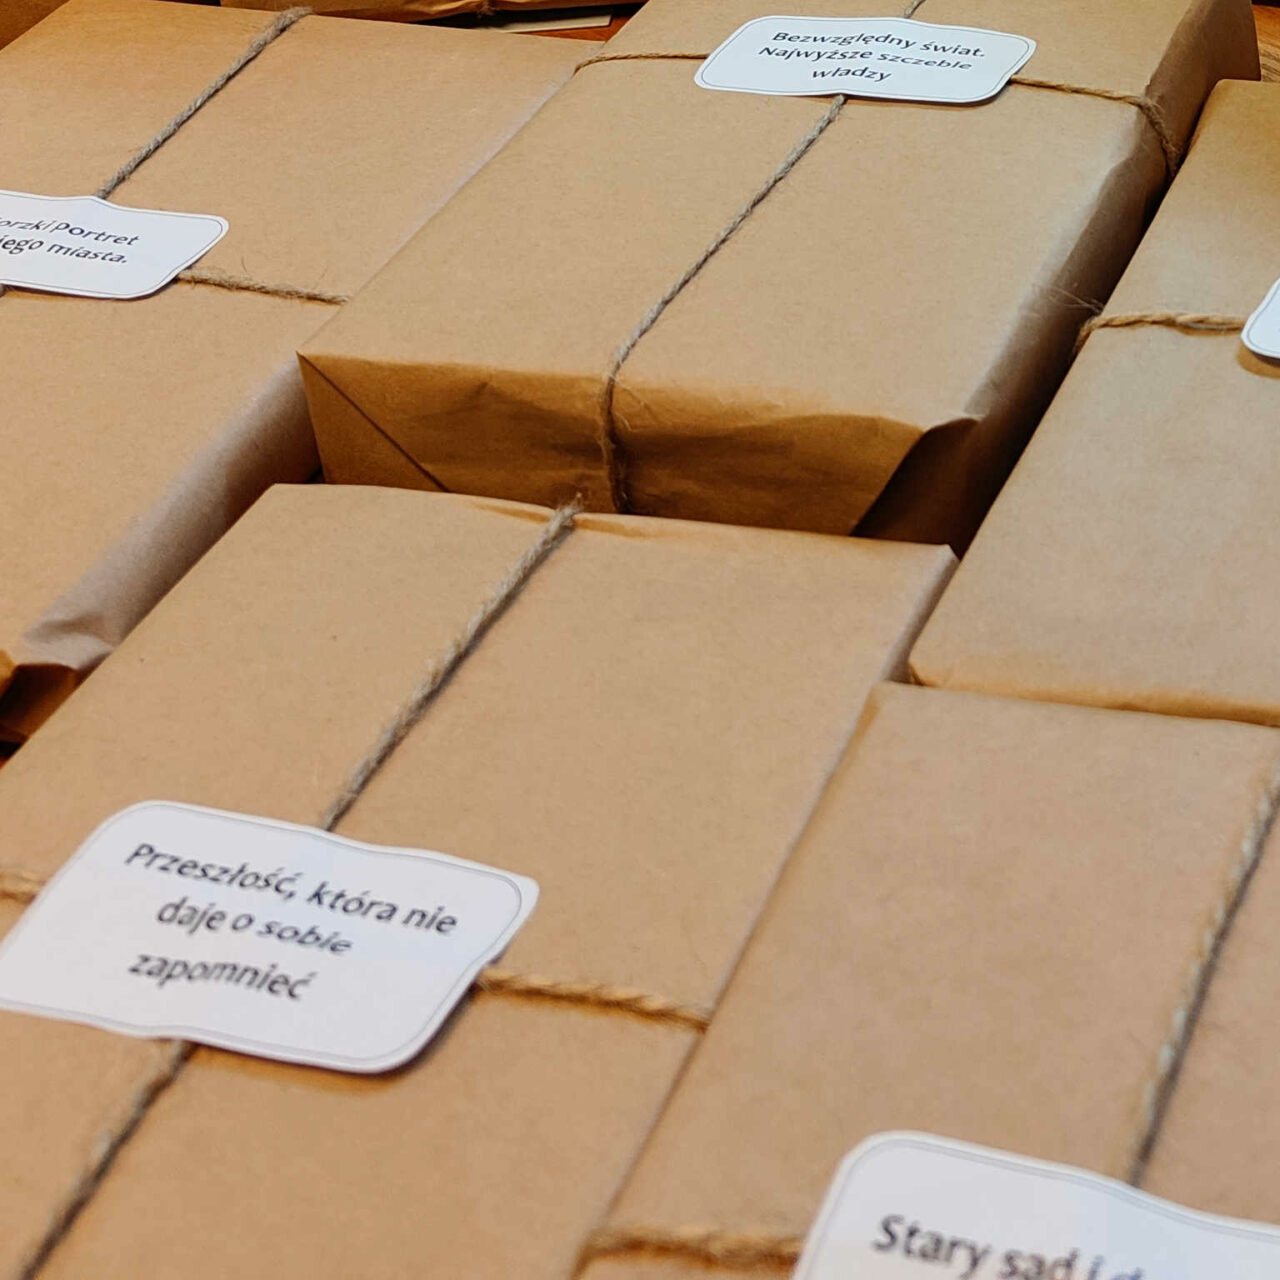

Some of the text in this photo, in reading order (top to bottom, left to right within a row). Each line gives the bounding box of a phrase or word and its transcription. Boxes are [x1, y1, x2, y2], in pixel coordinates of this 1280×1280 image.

[758, 46, 972, 70] Najwyższe szczeble
[772, 32, 986, 58] Bezwzględny świat.
[49, 222, 140, 247] Portret
[125, 842, 457, 934] Przeszłość, która nie
[157, 896, 352, 954] daje o sobie
[128, 953, 318, 1001] zapomnieć
[872, 1214, 991, 1280] Stary
